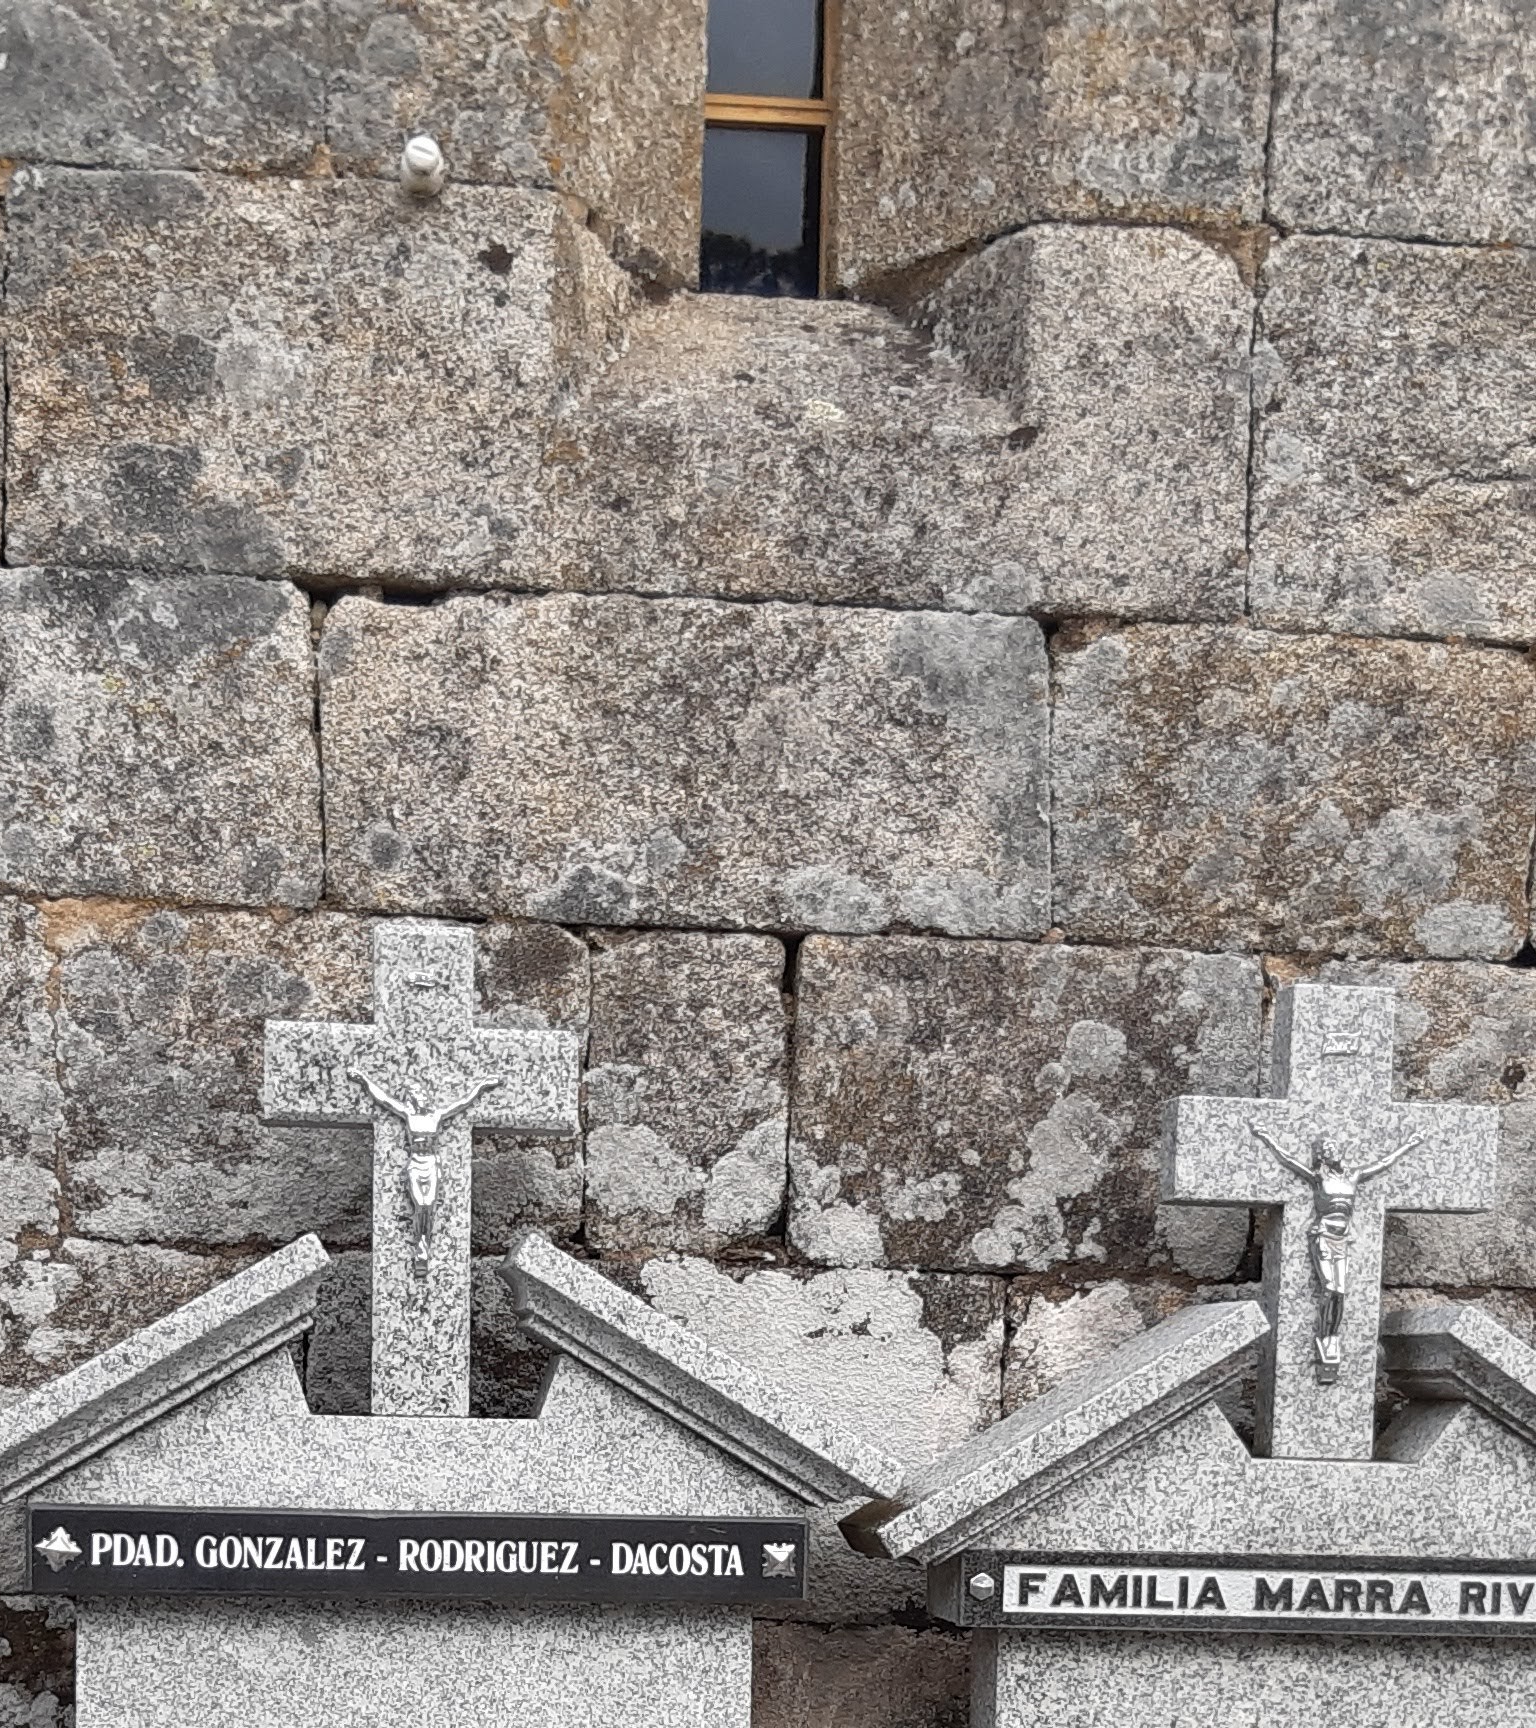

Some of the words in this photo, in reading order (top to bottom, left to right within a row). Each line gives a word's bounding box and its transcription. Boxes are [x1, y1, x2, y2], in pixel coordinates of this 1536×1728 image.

[90, 1532, 185, 1568] PDAD.
[194, 1535, 366, 1571] GONZALEZ
[397, 1539, 579, 1576] RODRIGUEZ
[611, 1542, 745, 1577] DACOSTA
[1016, 1572, 1228, 1612] FAMILIA
[1252, 1577, 1431, 1616] MARRA
